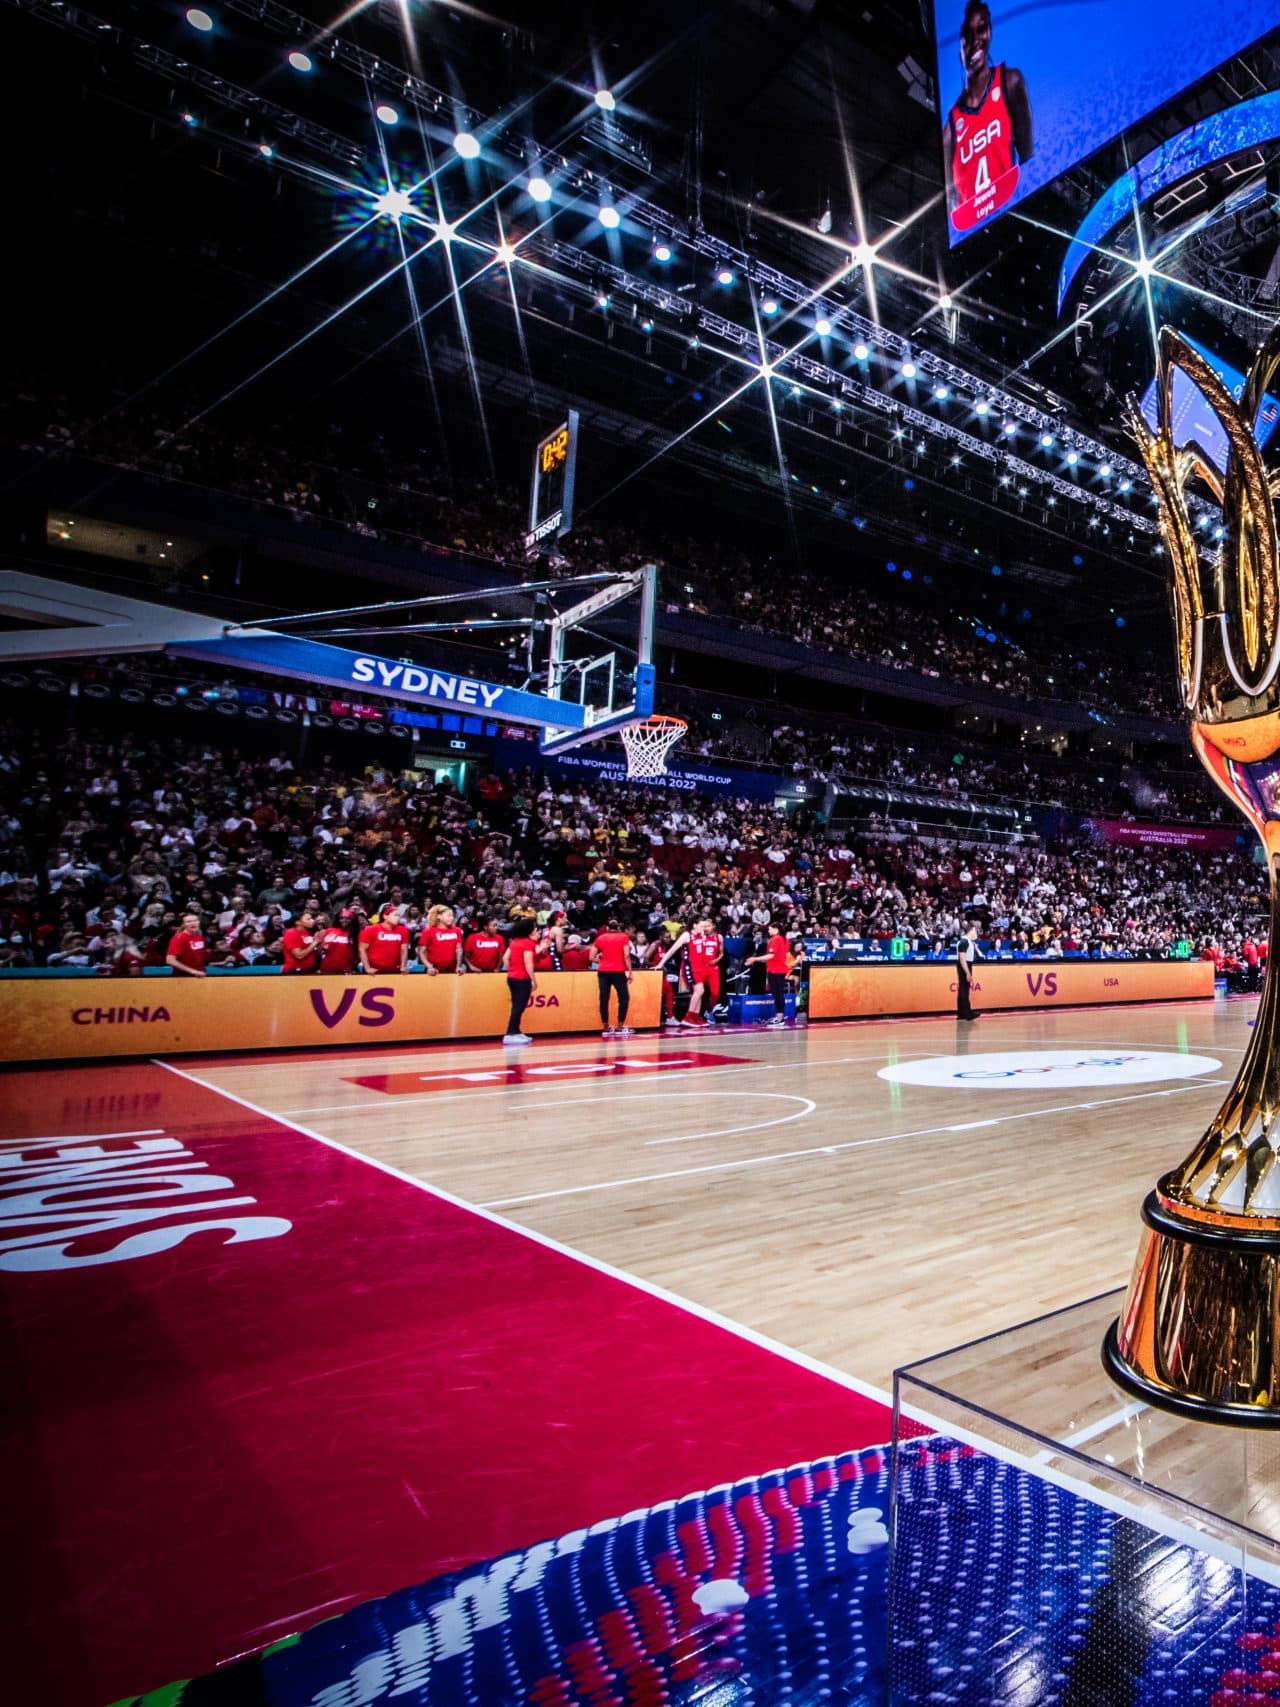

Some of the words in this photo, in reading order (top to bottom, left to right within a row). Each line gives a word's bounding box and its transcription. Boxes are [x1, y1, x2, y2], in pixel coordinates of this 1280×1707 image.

[960, 118, 1001, 165] USA
[974, 154, 992, 196] 4
[352, 657, 504, 708] SYDNEY
[557, 755, 580, 766] FIBA
[684, 771, 715, 783] WORLD
[716, 775, 732, 785] CUP
[669, 777, 697, 790] 2022
[949, 982, 981, 993] CNA
[1027, 972, 1058, 997] VS
[1103, 978, 1120, 987] USA
[72, 1005, 171, 1026] CHINA
[309, 986, 396, 1029] VS
[952, 1055, 1153, 1079] Google
